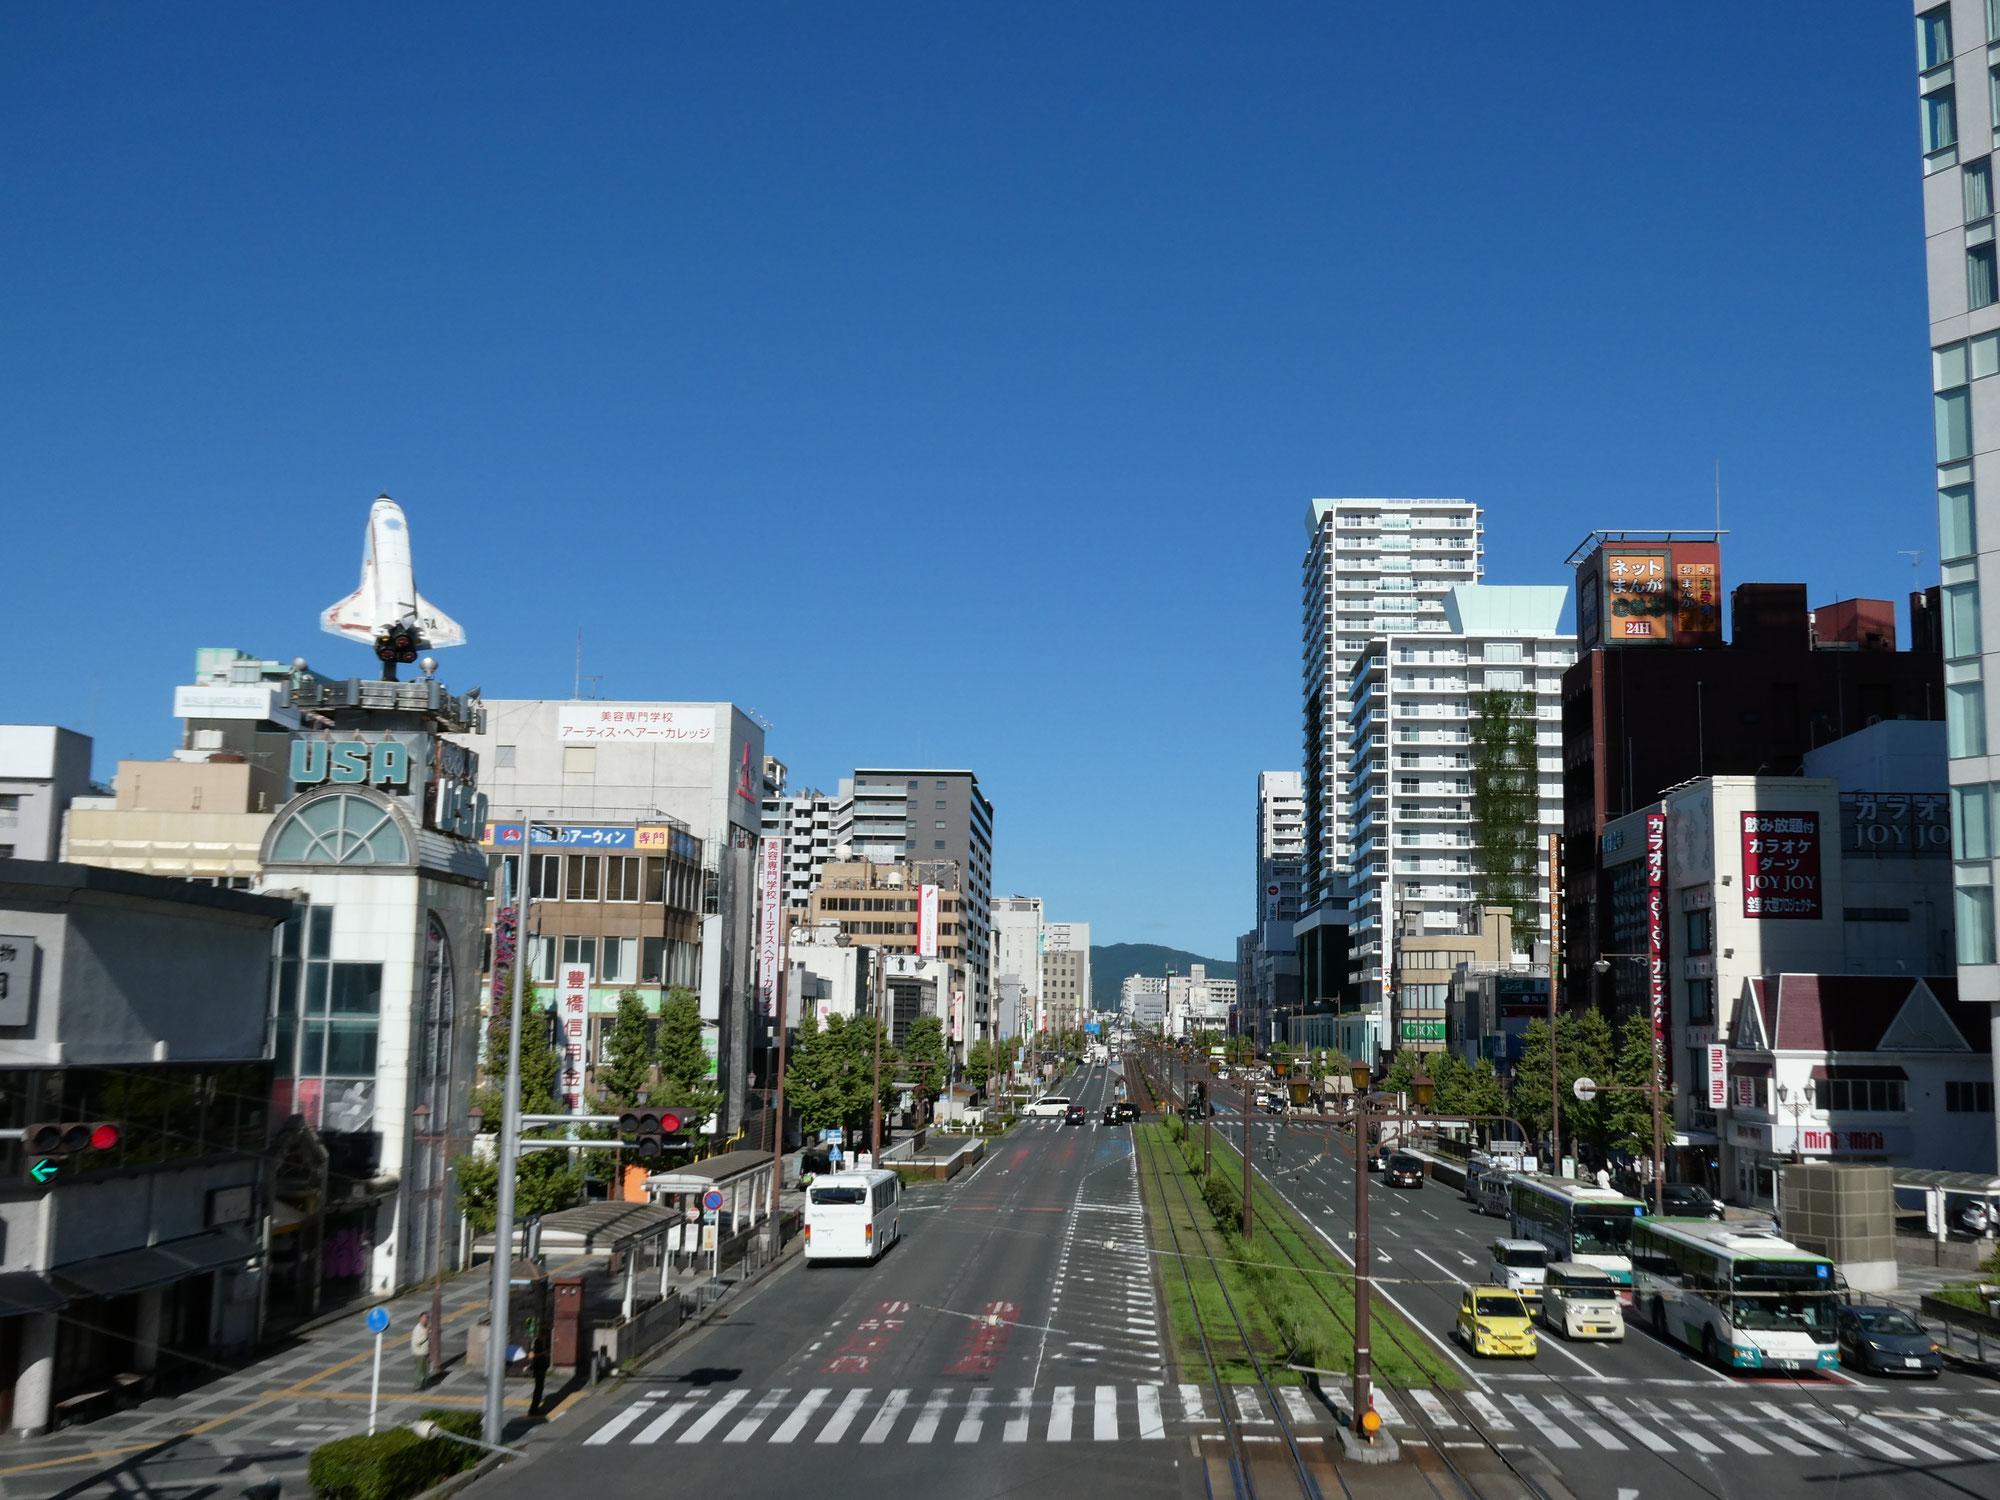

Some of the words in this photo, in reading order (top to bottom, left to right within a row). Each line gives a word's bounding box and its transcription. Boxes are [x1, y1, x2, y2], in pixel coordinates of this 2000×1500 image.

[1612, 559, 1662, 576] ネット
[1680, 566, 1693, 574] 3F
[1699, 566, 1711, 574] 4F
[1612, 578, 1663, 594] まんが
[1626, 622, 1650, 634] 24H
[601, 711, 673, 723] 美容専門学校
[562, 726, 711, 739] アーティス・ヘアー・カレッジ
[289, 739, 408, 784] USA
[1855, 795, 1950, 820] カラオ
[1744, 817, 1814, 834] 飲み放題付
[638, 832, 665, 845] 専門
[1853, 823, 1908, 849] JOY
[1915, 824, 1950, 849] JO
[1649, 818, 1664, 882] カラオケ
[1749, 838, 1812, 854] カラオケ
[766, 841, 779, 900] 美容専門学校
[1760, 857, 1799, 871] ダーツ
[1747, 874, 1780, 892] JOY
[1783, 875, 1816, 892] JOY
[1650, 891, 1663, 921] JOY
[1652, 922, 1665, 950] JOY
[763, 903, 777, 1013] アーティス・ヘアー・カレッジ
[1652, 957, 1668, 1024] カラオケ
[562, 970, 585, 1110] 豊橋信用金庫
[1711, 1049, 1724, 1072] mini
[1712, 1080, 1725, 1104] mini
[1804, 1131, 1838, 1149] mini
[1850, 1132, 1884, 1150] mini
